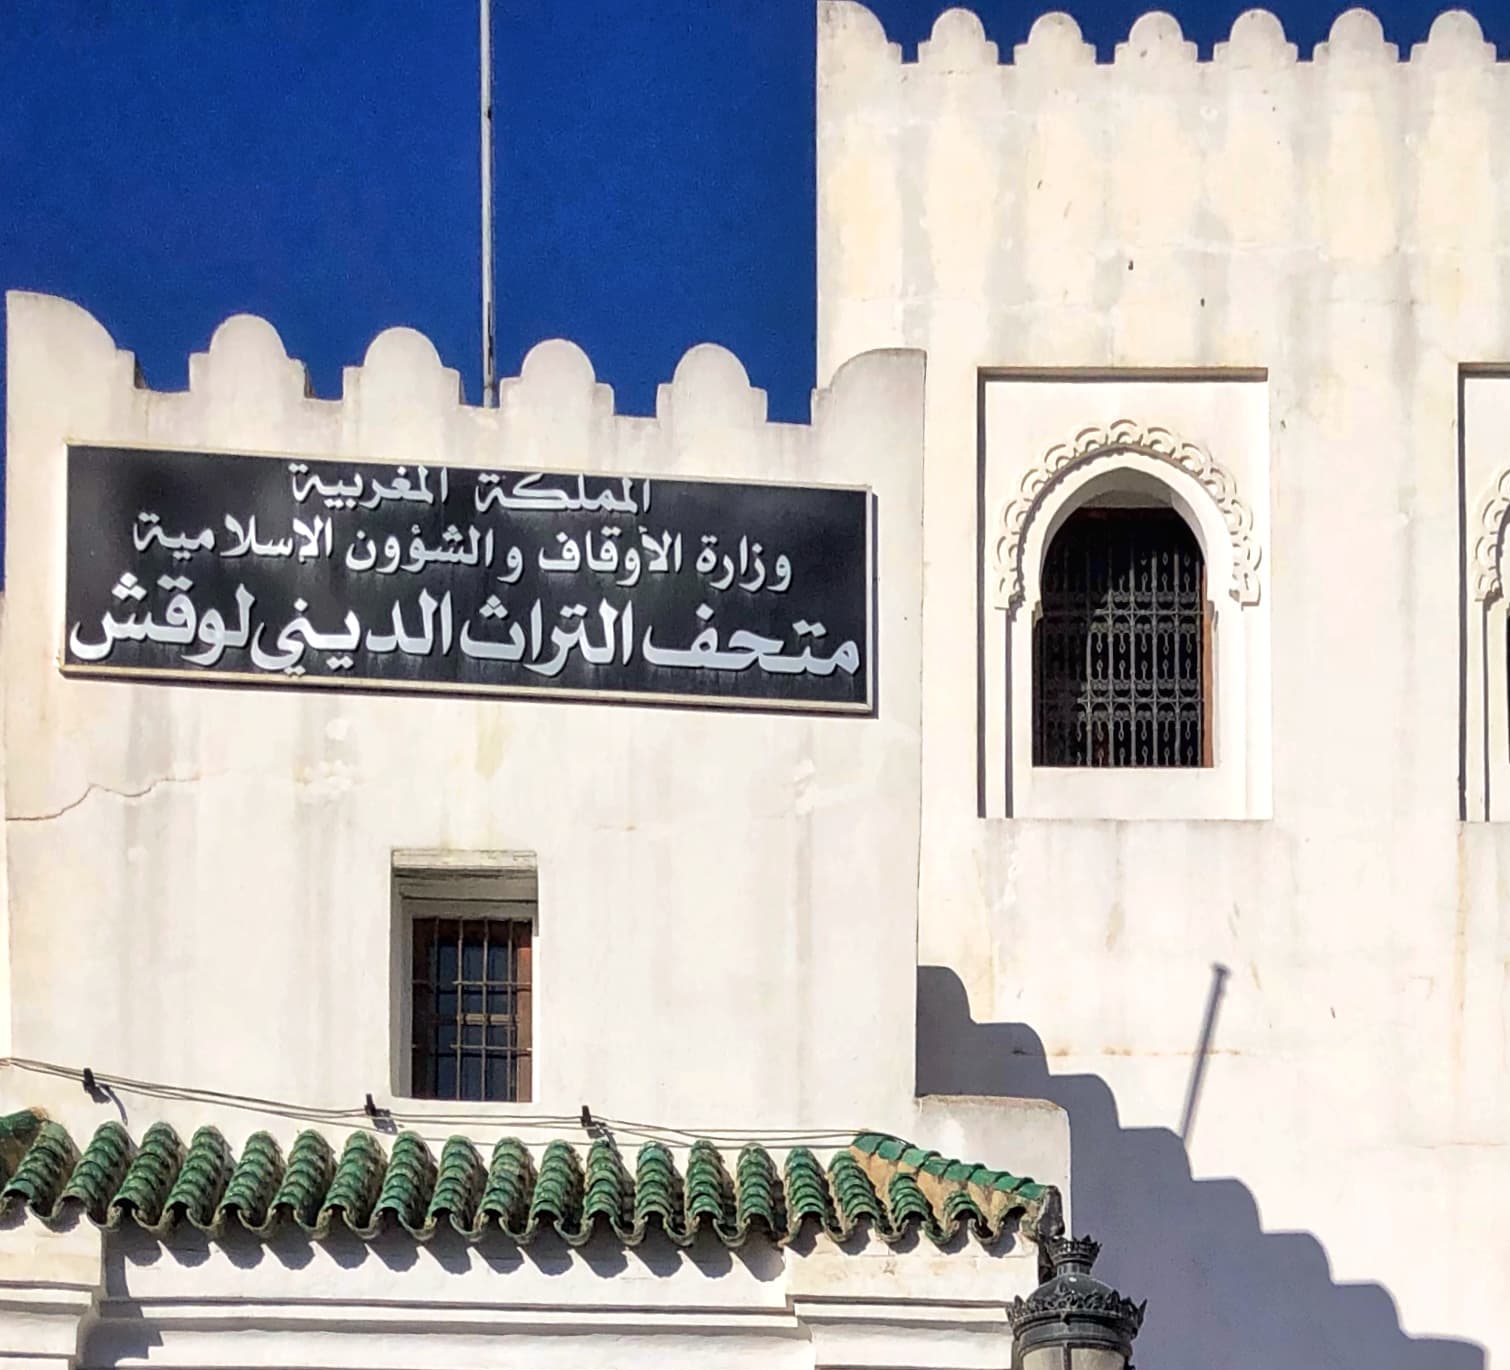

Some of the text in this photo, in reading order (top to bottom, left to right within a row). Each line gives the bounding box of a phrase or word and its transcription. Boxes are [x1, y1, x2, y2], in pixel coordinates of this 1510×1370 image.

[287, 461, 651, 515] المملكة المغربية
[132, 511, 334, 563] الإسلامية
[537, 525, 683, 586] الأوقاف
[695, 534, 793, 592] وزارة
[69, 571, 860, 677] متحف التراث الديني لوقش
